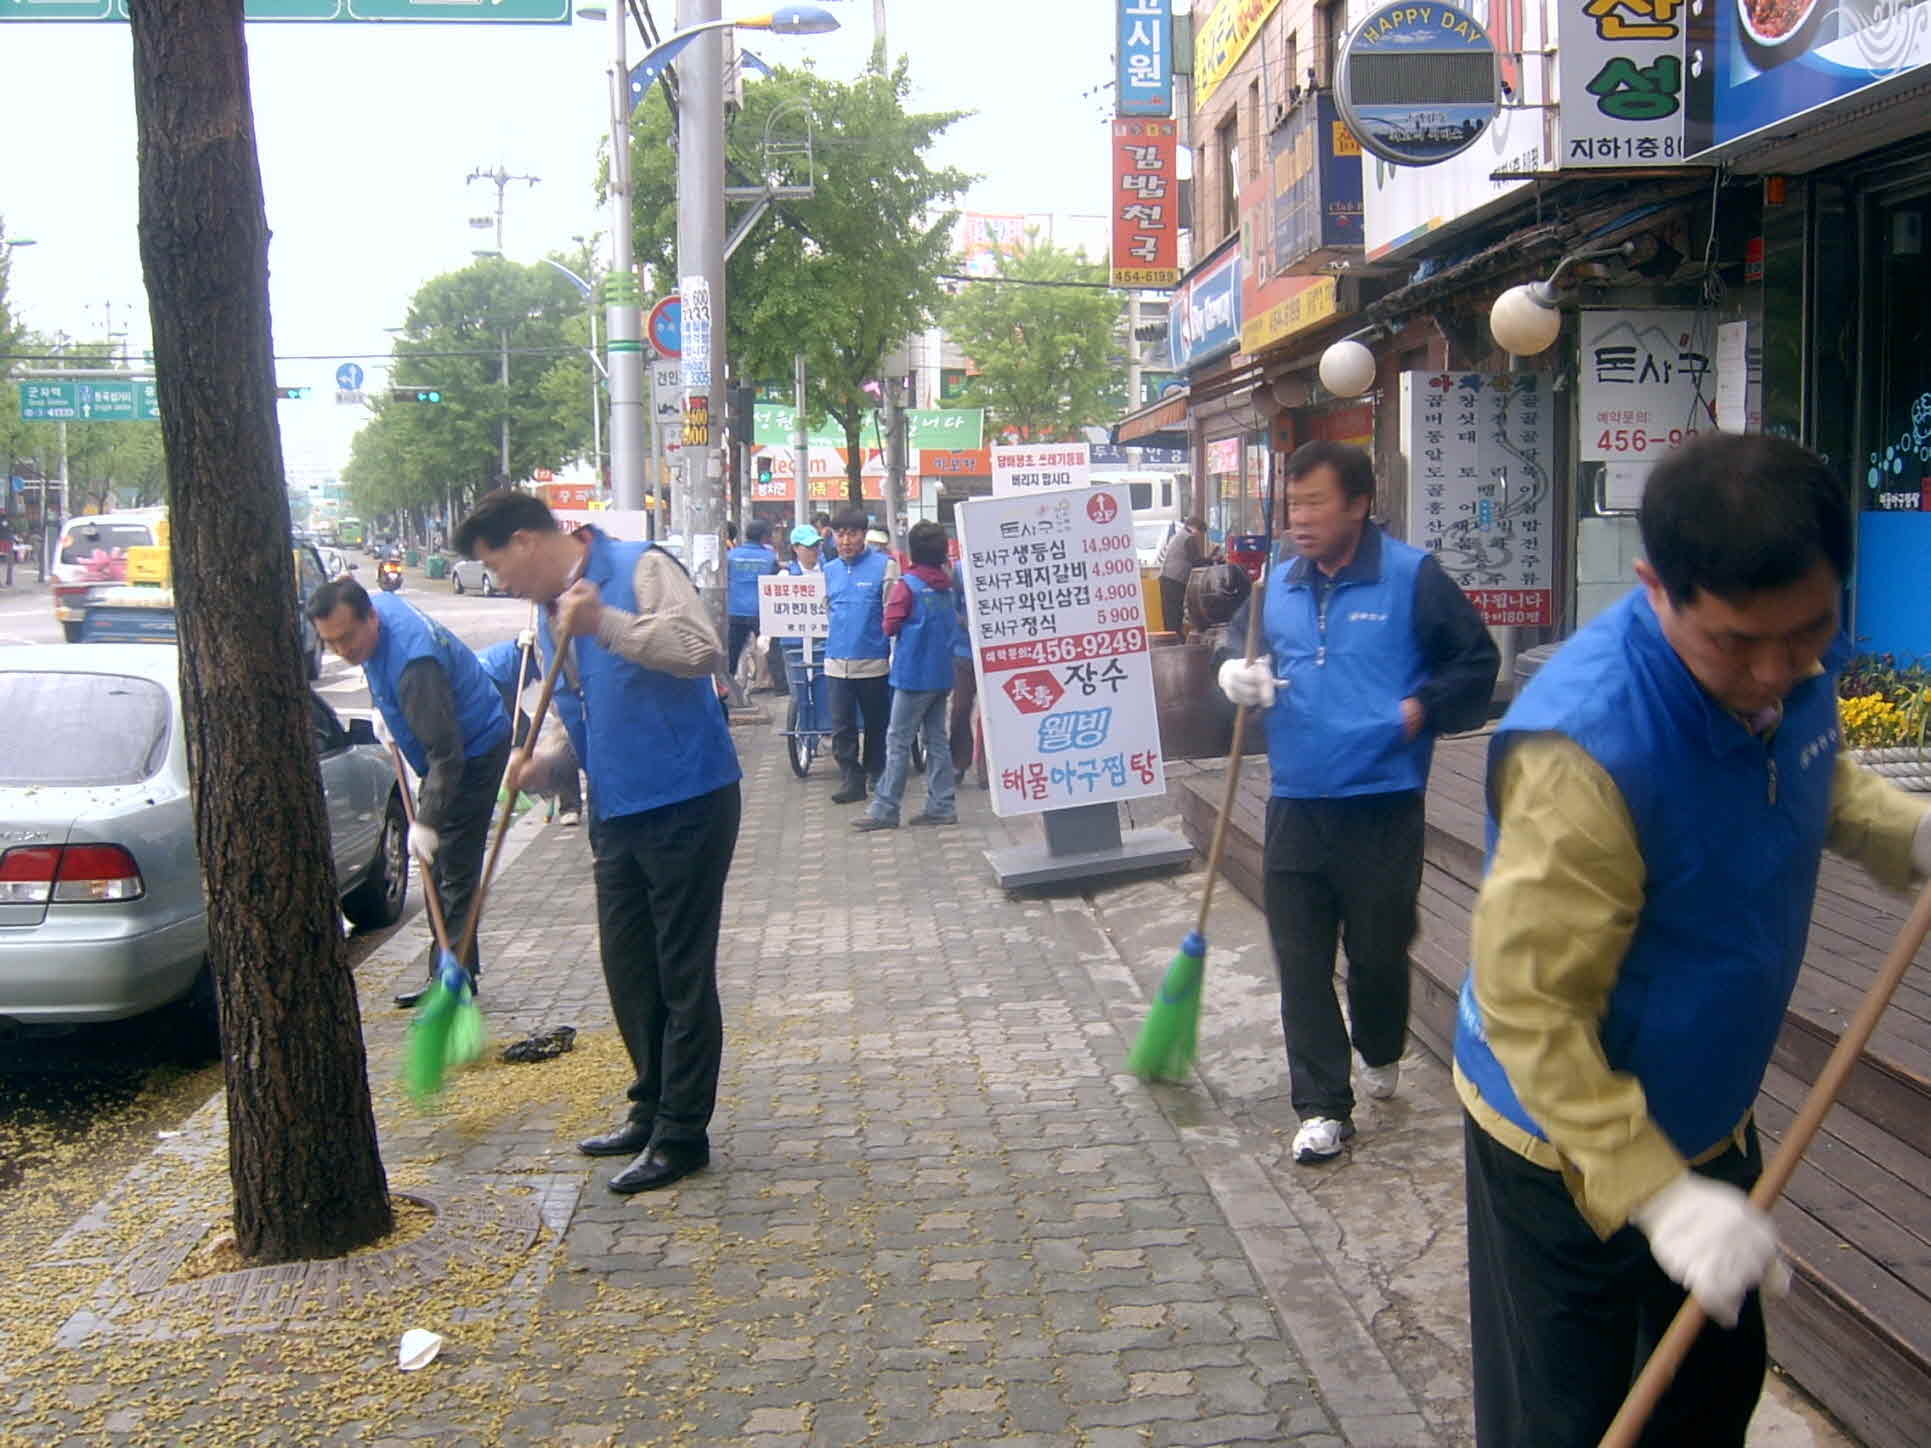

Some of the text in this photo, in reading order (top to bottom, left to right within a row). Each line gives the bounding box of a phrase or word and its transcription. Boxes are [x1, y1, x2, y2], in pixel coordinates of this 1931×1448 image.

[1363, 7, 1482, 44] HAPPY DAY
[1571, 137, 1659, 158] 지하1층
[1120, 143, 1167, 262] 김밥천국
[1597, 429, 1698, 452] 456-9
[971, 548, 1009, 568] 돈사구
[1012, 540, 1067, 565] 생등심
[975, 571, 1013, 592] 돈사구
[1015, 561, 1088, 588] 돼지갈비
[978, 594, 1015, 617] 돈사구
[1018, 585, 1091, 612] 와인삼겹
[981, 618, 1019, 640] 돈사구
[1021, 614, 1057, 637] 정식
[1031, 628, 1142, 664] 456-9249
[1064, 658, 1128, 696] 장수
[1038, 707, 1113, 753] 웰빙
